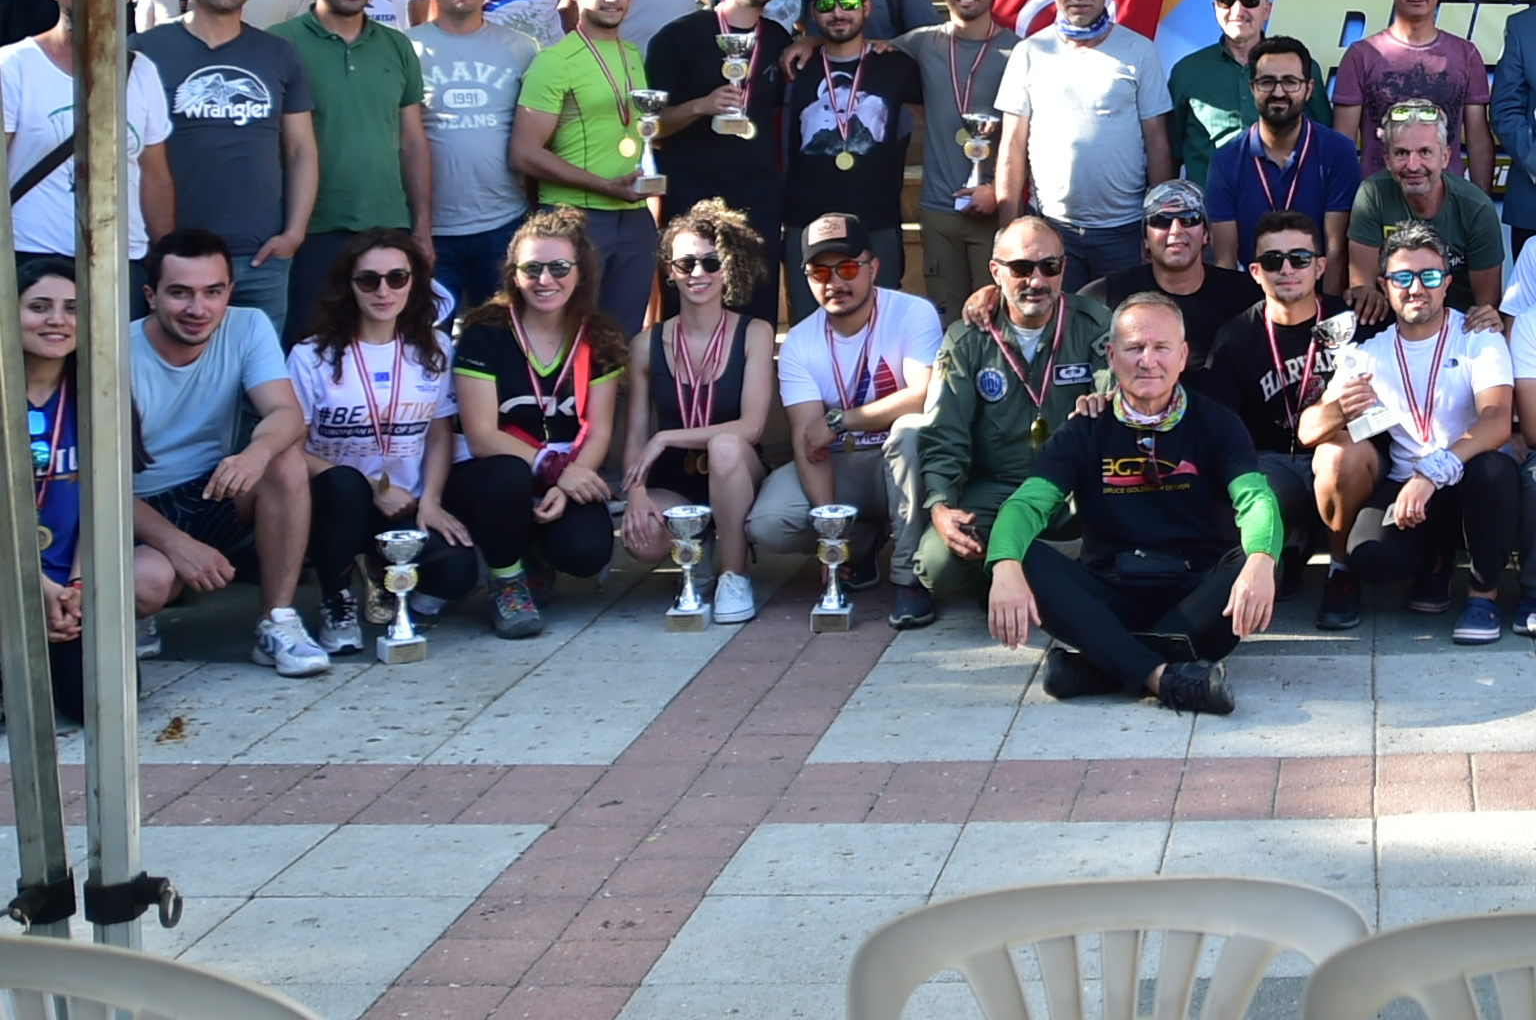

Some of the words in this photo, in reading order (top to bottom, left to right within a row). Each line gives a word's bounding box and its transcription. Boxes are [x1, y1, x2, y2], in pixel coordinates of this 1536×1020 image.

[452, 92, 479, 105] 1991
[436, 113, 498, 130] JEANS
[1102, 486, 1125, 495] BRUCE
